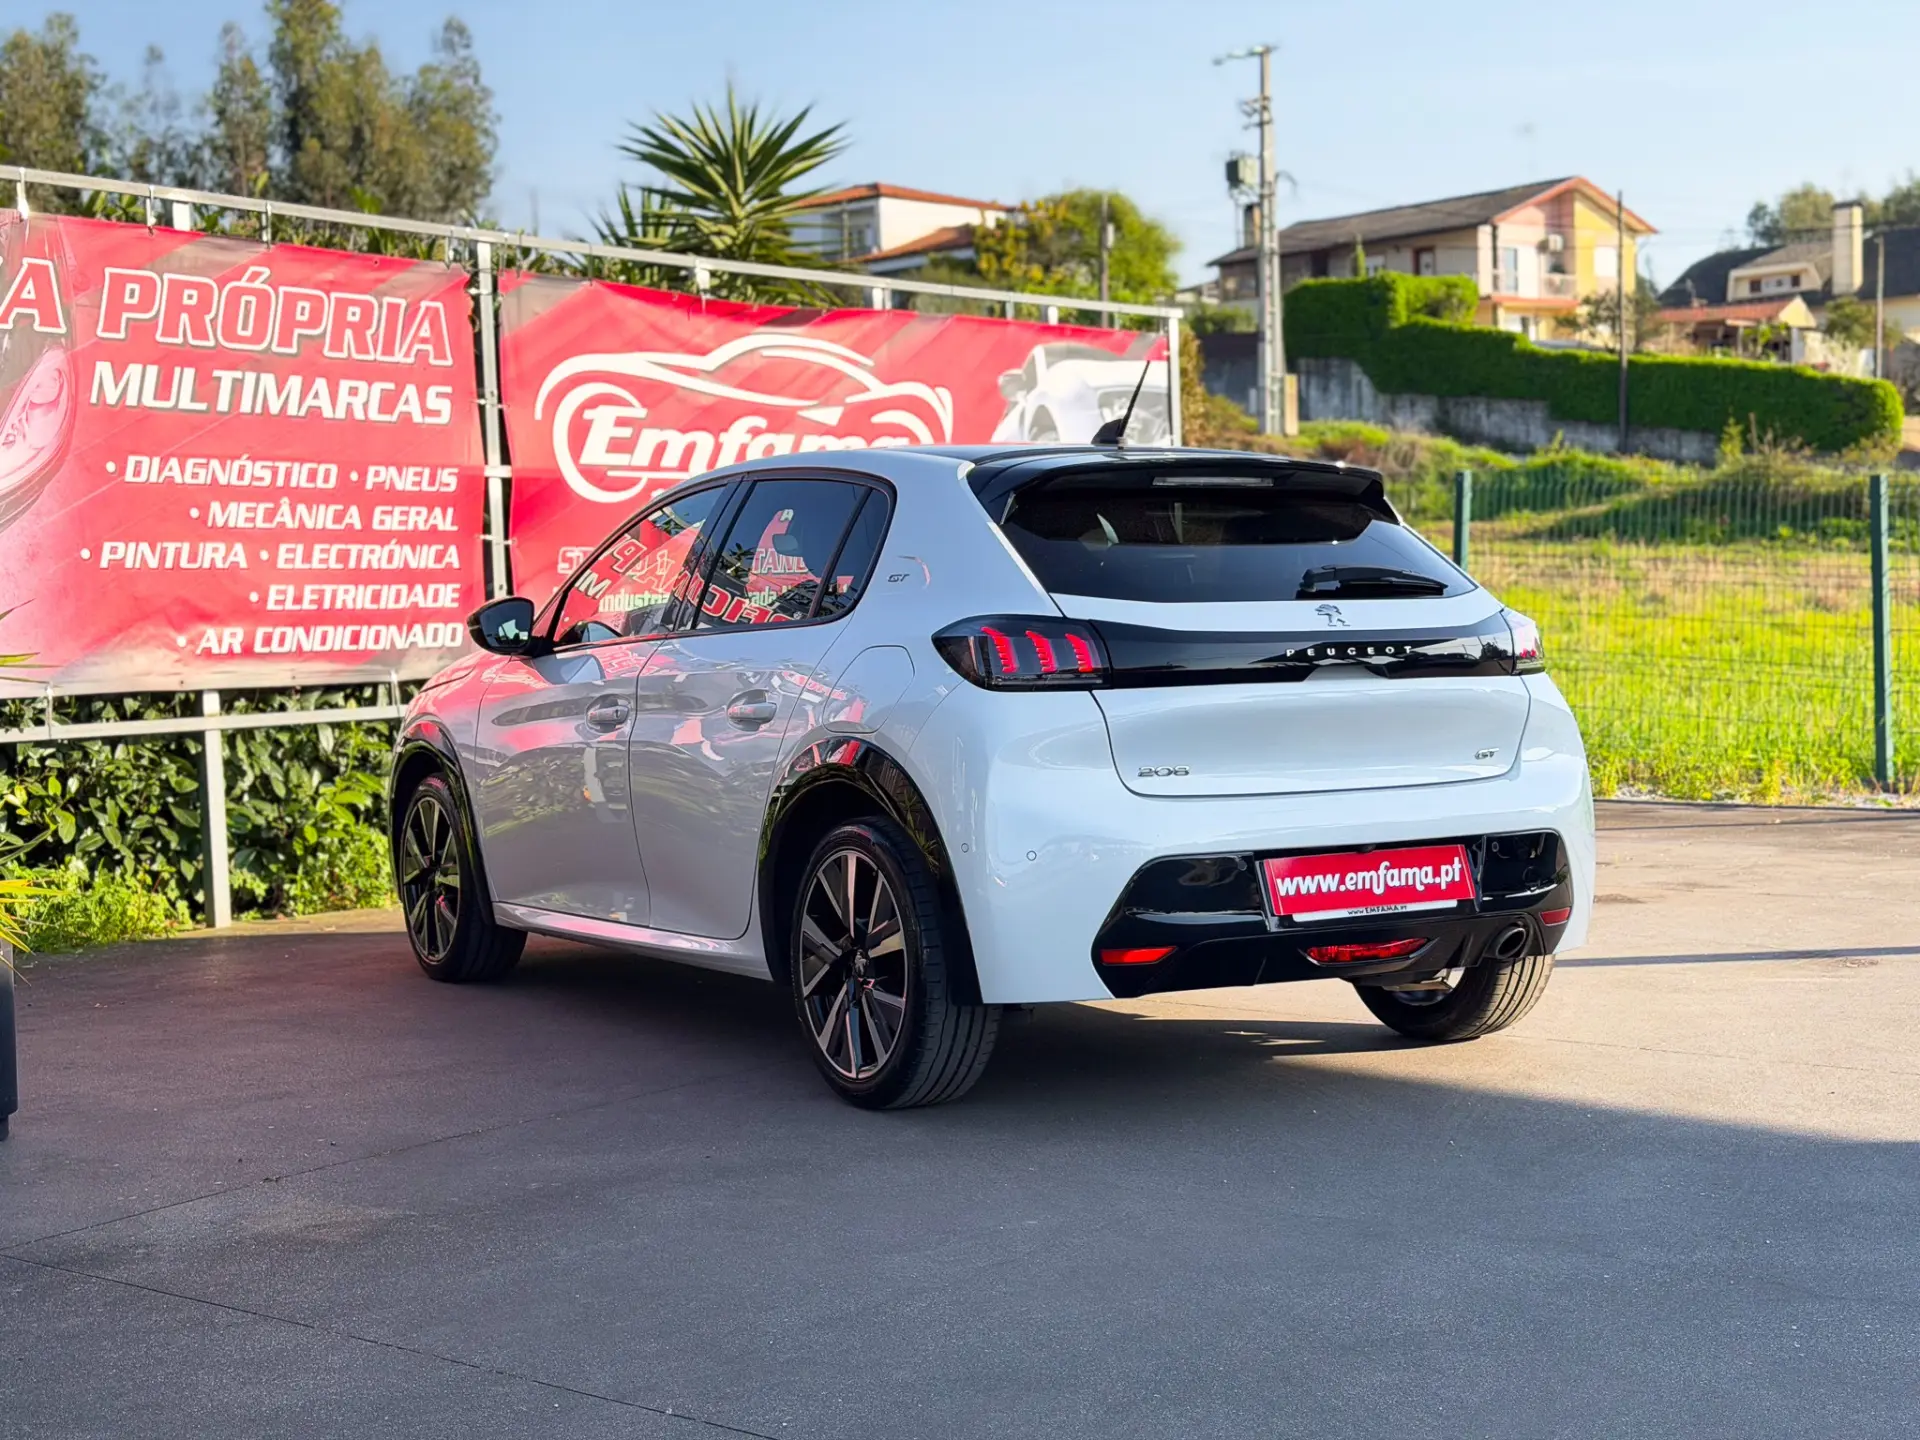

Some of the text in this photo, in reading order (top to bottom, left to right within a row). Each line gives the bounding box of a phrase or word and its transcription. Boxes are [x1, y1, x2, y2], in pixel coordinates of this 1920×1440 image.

[96, 266, 453, 367] PRÓPRIA
[90, 361, 453, 425] MULTIMARCAS
[125, 454, 458, 492] DIAGNÓSTICO PNEUS
[208, 497, 458, 531] MECÂNICA GERAL
[100, 539, 459, 570] PINTURA ELECTRÓNICA
[887, 574, 910, 583] GT
[267, 584, 461, 611] ELETRICIDADE
[196, 623, 465, 655] AR CONDICIONADO
[1286, 645, 1412, 657] PEUGEOT
[1475, 747, 1500, 760] GT
[1138, 765, 1190, 777] 208
[1277, 857, 1462, 896] www.emfama.pt
